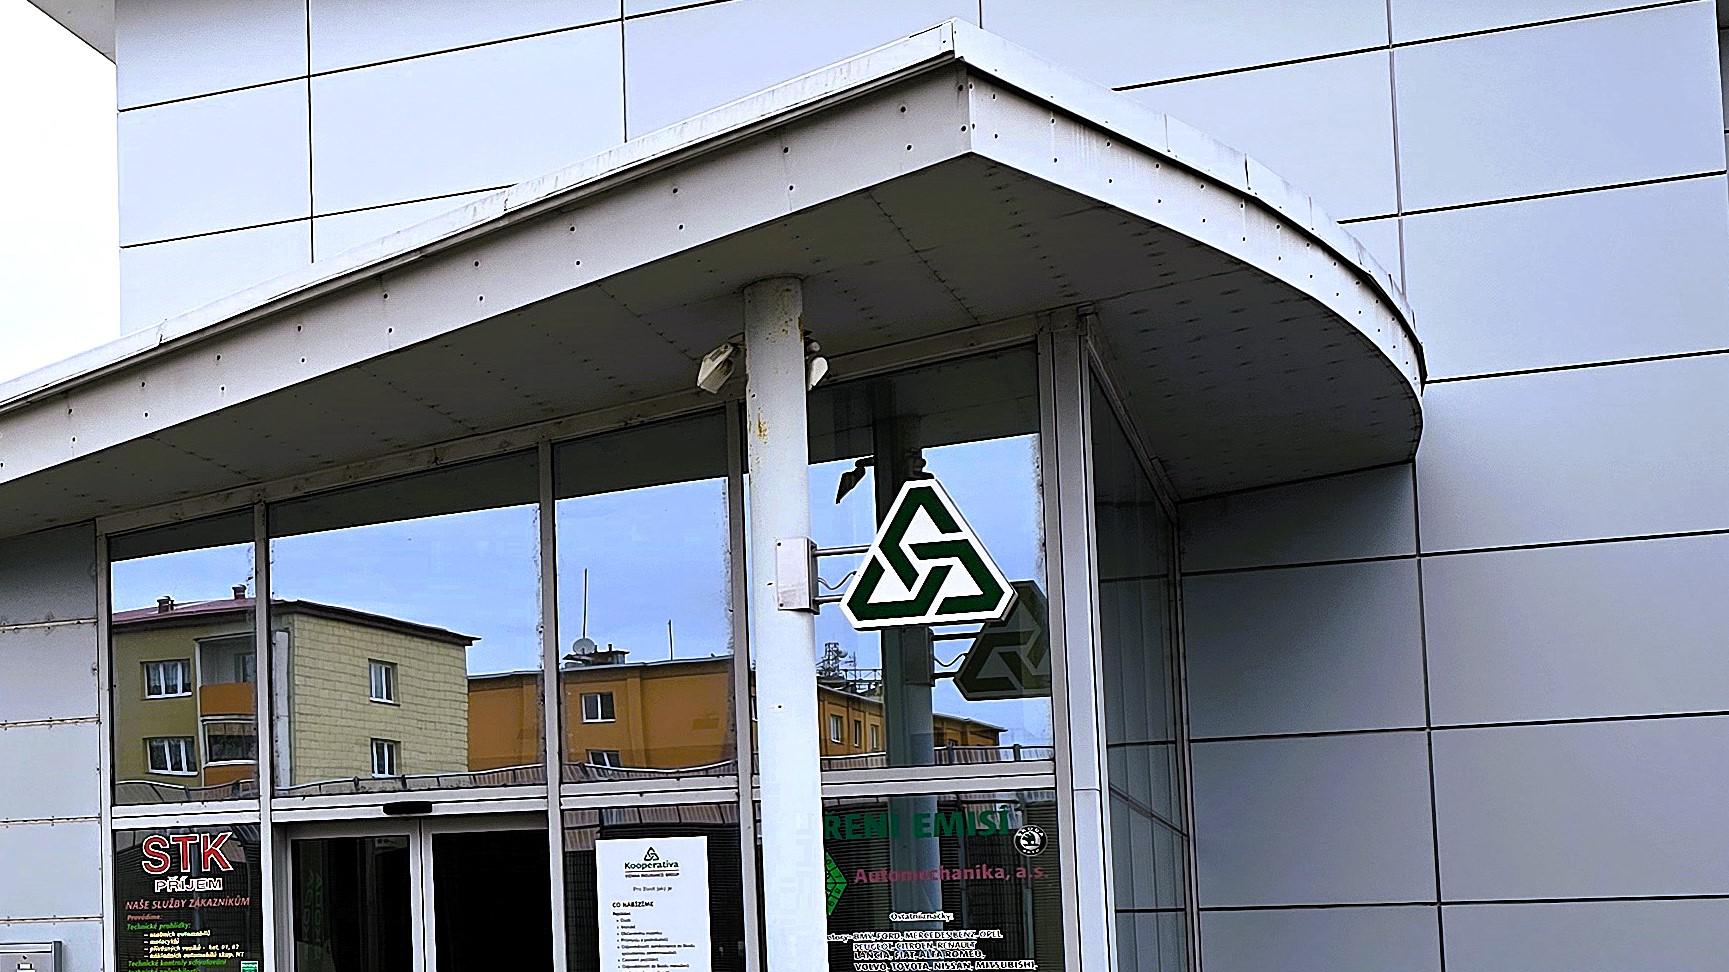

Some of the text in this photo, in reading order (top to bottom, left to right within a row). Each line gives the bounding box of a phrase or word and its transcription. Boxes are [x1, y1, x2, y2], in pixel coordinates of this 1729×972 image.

[142, 832, 234, 874] STK
[625, 860, 679, 869] Kooperativa
[155, 876, 223, 892] PŘÍJEM
[126, 895, 250, 909] NAŠE SLUŽBY ZÁKAZNÍKŮM
